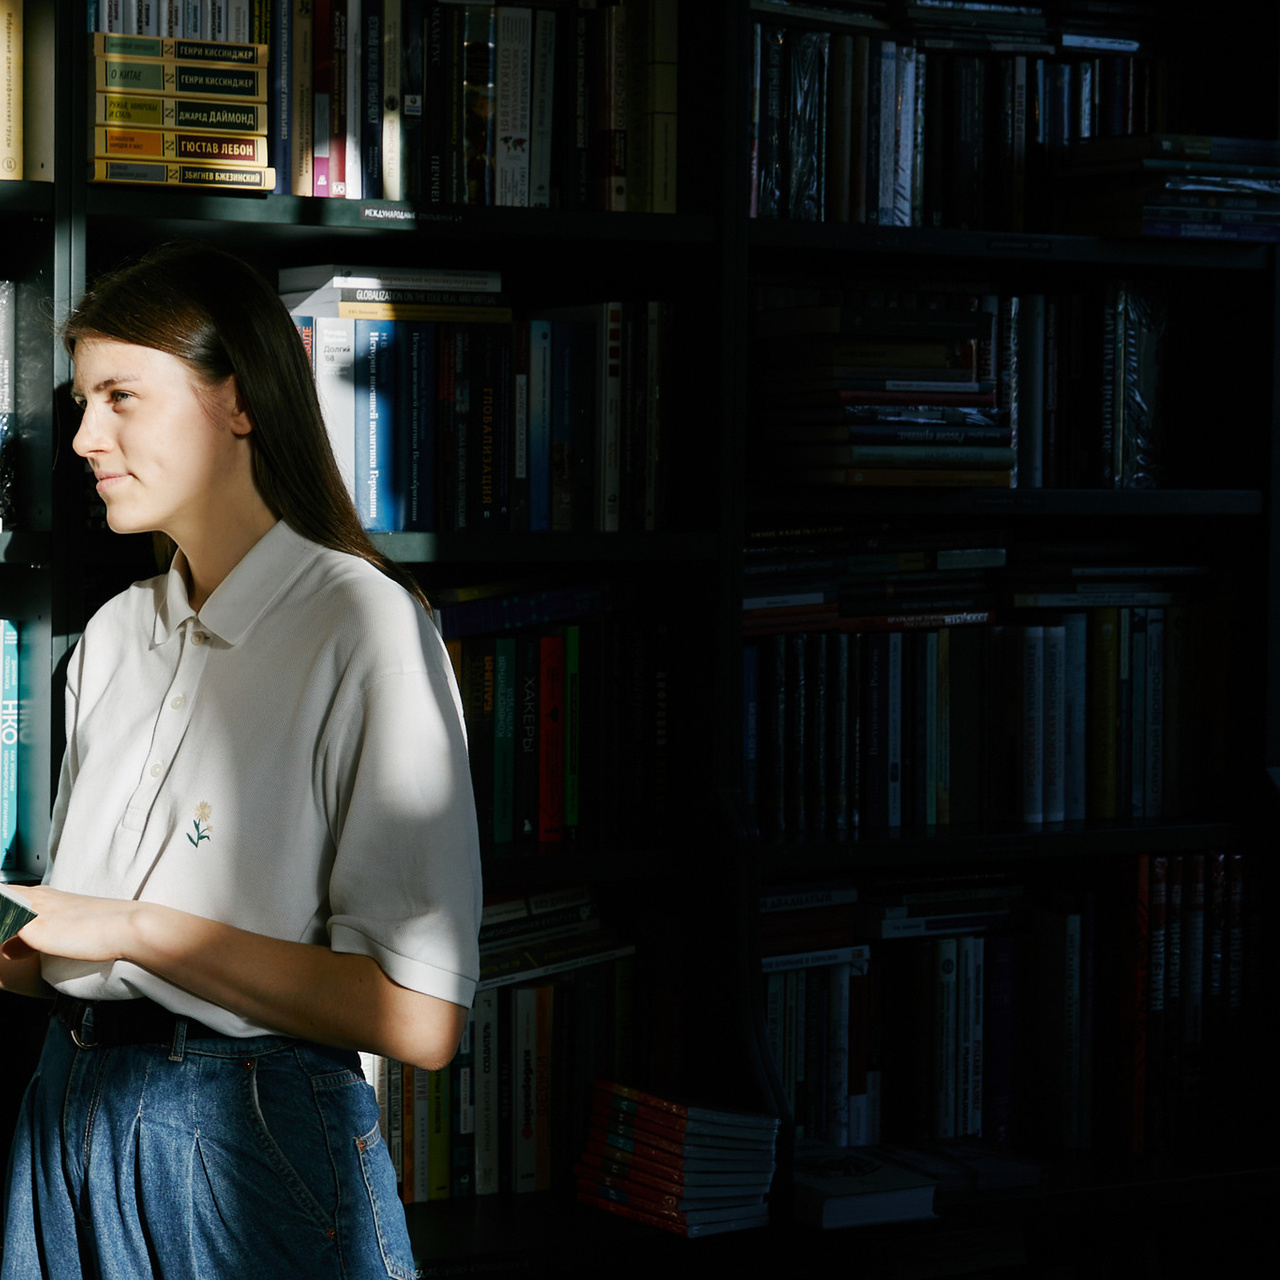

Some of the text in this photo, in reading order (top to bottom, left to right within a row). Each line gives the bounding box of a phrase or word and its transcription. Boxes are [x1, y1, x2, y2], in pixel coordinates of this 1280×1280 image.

[179, 45, 254, 60] ГЕНРИ КИССИНДЖЕР
[181, 75, 254, 88] ГЕНРИ КИССИНДЖЕР
[179, 110, 255, 126] ДЖАРЕД ДАЙМОНД
[181, 140, 254, 156] ГЮСТАВ ЛЕБОН
[184, 171, 260, 183] ЗБИГНЕВ БЖЕЗИНСКИЙ
[356, 289, 403, 302] GLOBALIZATION
[323, 345, 351, 355] Долгий
[368, 421, 379, 519] политики Германии
[2, 700, 18, 745] НКО
